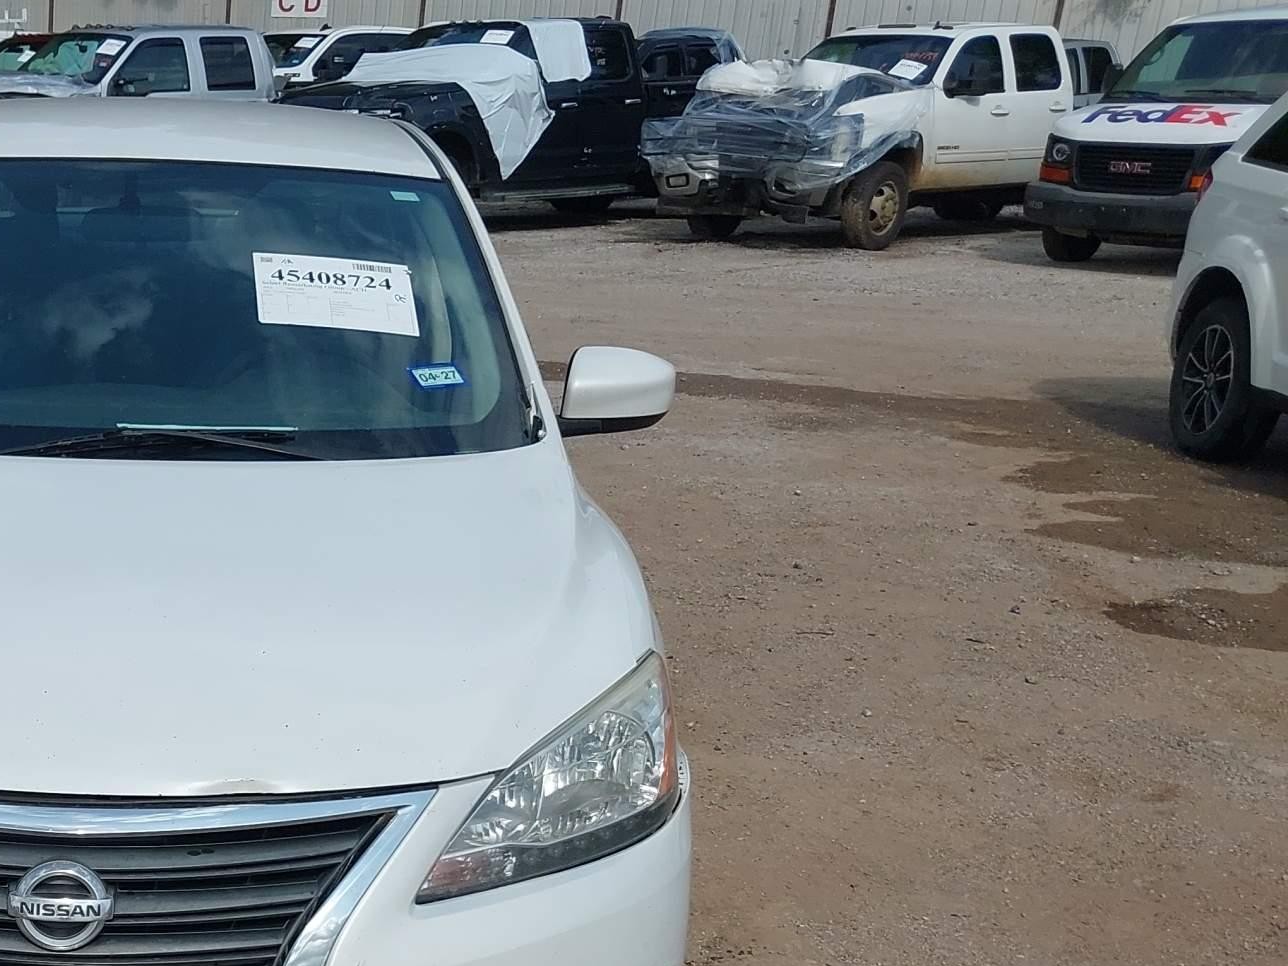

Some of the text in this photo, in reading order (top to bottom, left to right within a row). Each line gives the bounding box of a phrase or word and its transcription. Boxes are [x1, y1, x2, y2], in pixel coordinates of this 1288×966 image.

[1081, 104, 1243, 127] FedEx
[1109, 160, 1152, 174] GMC
[270, 268, 393, 291] 45408724
[19, 901, 101, 917] NISSAN
